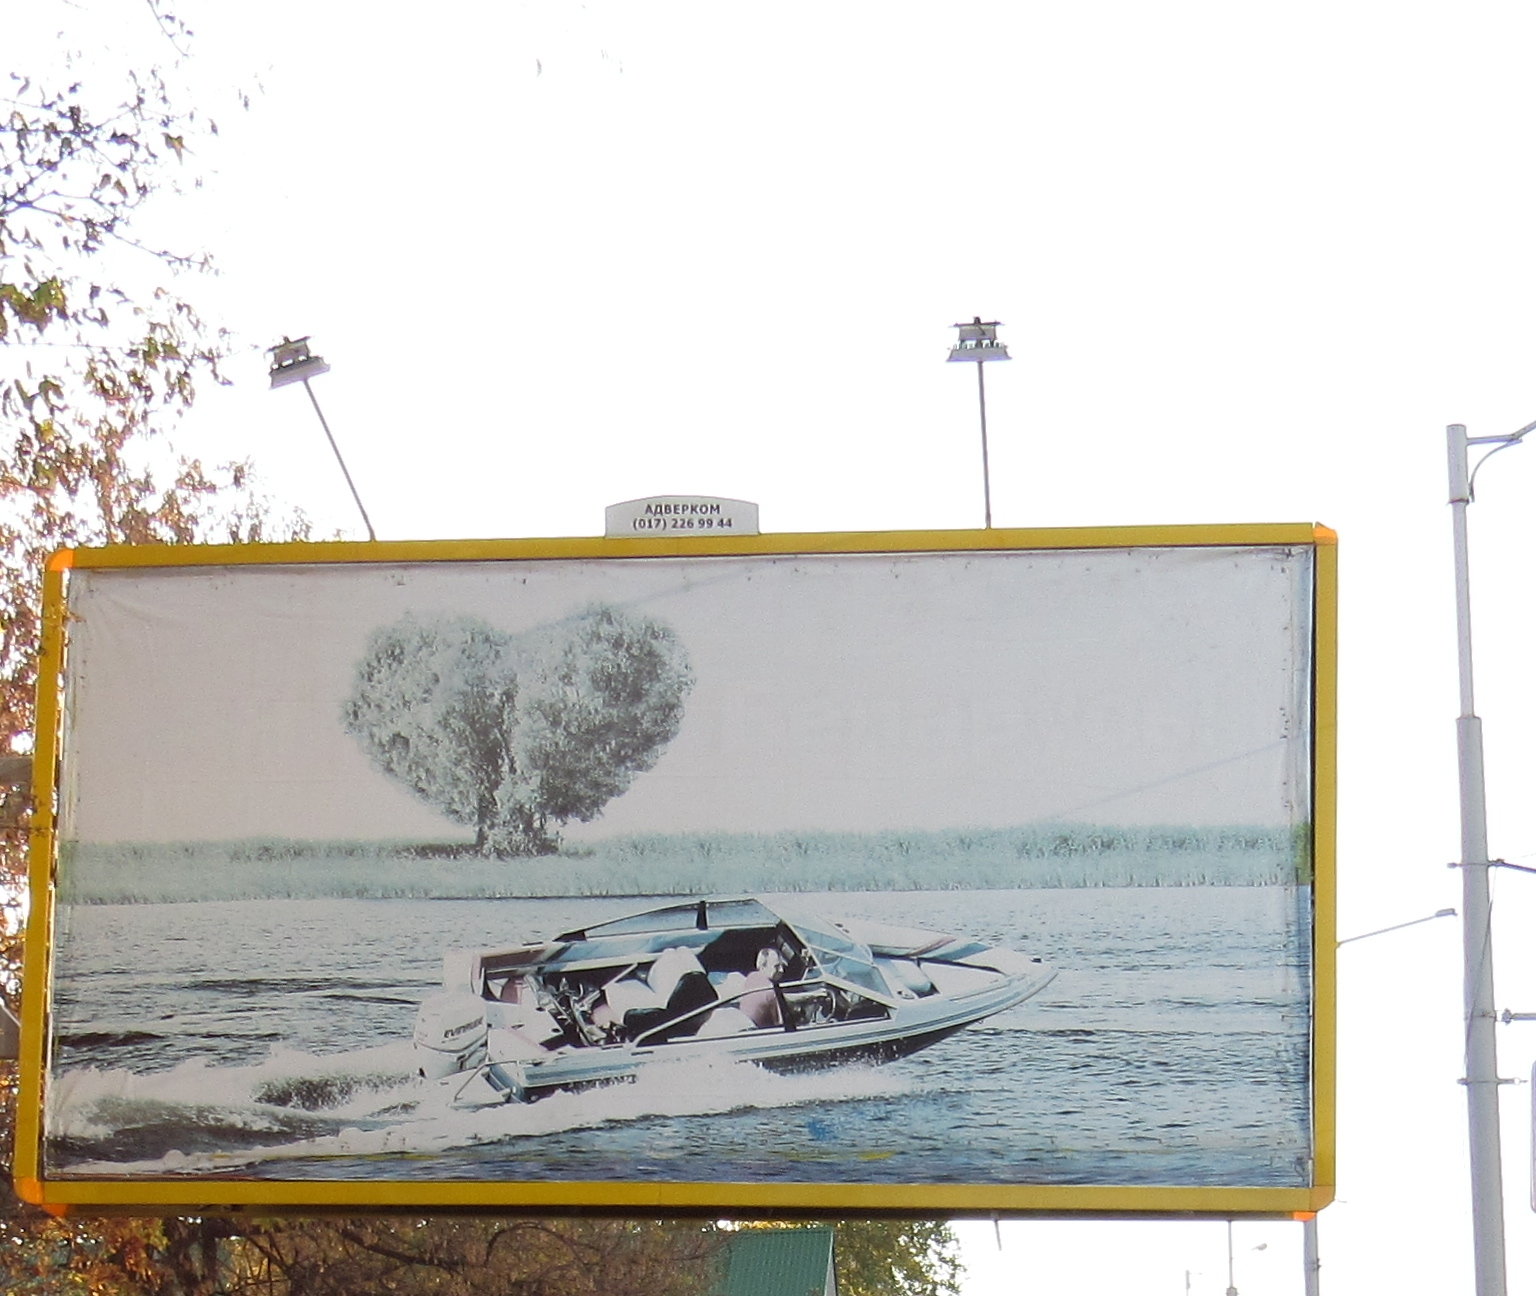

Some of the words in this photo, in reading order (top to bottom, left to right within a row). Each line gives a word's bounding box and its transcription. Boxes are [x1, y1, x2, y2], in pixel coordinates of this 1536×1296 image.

[644, 504, 720, 516] АДВЕРКОМ
[632, 518, 667, 531] (017)
[671, 518, 694, 529] 226
[698, 518, 713, 529] 99
[717, 518, 732, 528] 44
